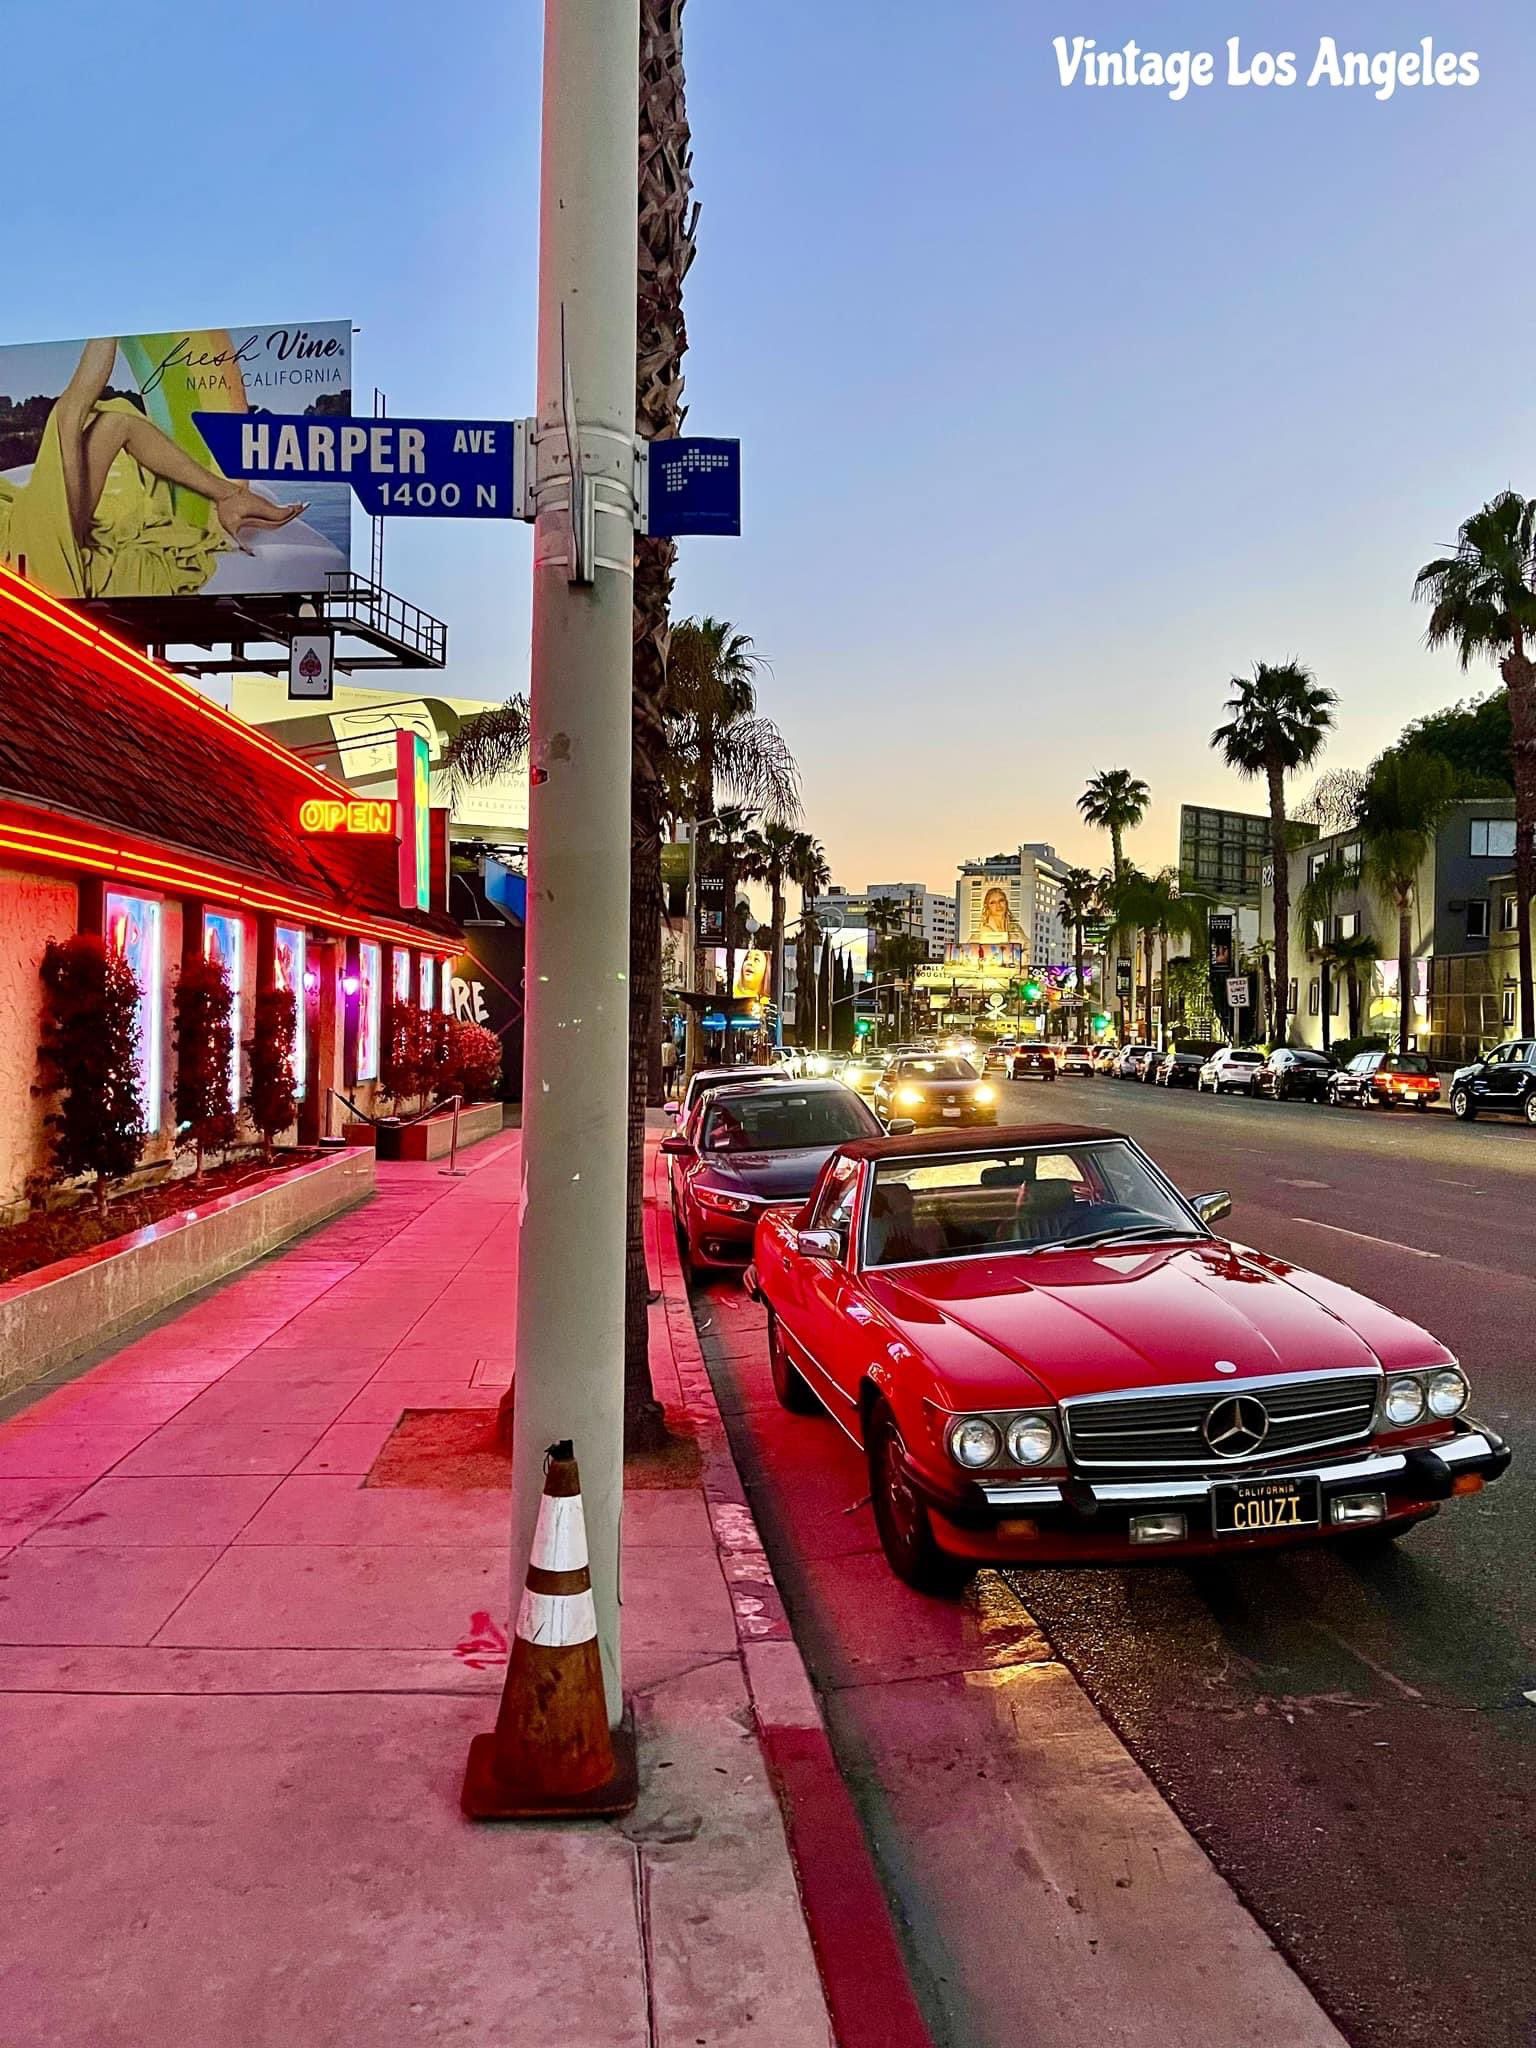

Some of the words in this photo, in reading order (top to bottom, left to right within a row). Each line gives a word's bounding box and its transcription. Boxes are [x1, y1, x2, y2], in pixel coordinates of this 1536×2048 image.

[141, 334, 261, 395] fresh
[186, 375, 232, 391] NAPA,
[241, 367, 342, 388] CALIFORNIA
[242, 423, 426, 474] HARPER
[453, 429, 497, 454] AVE
[378, 482, 461, 507] 1400
[477, 485, 497, 508] N
[300, 799, 392, 833] OPEN
[1231, 994, 1246, 1005] 35
[1239, 1484, 1295, 1498] CALIFORNIA
[1234, 1496, 1302, 1529] COUZI
